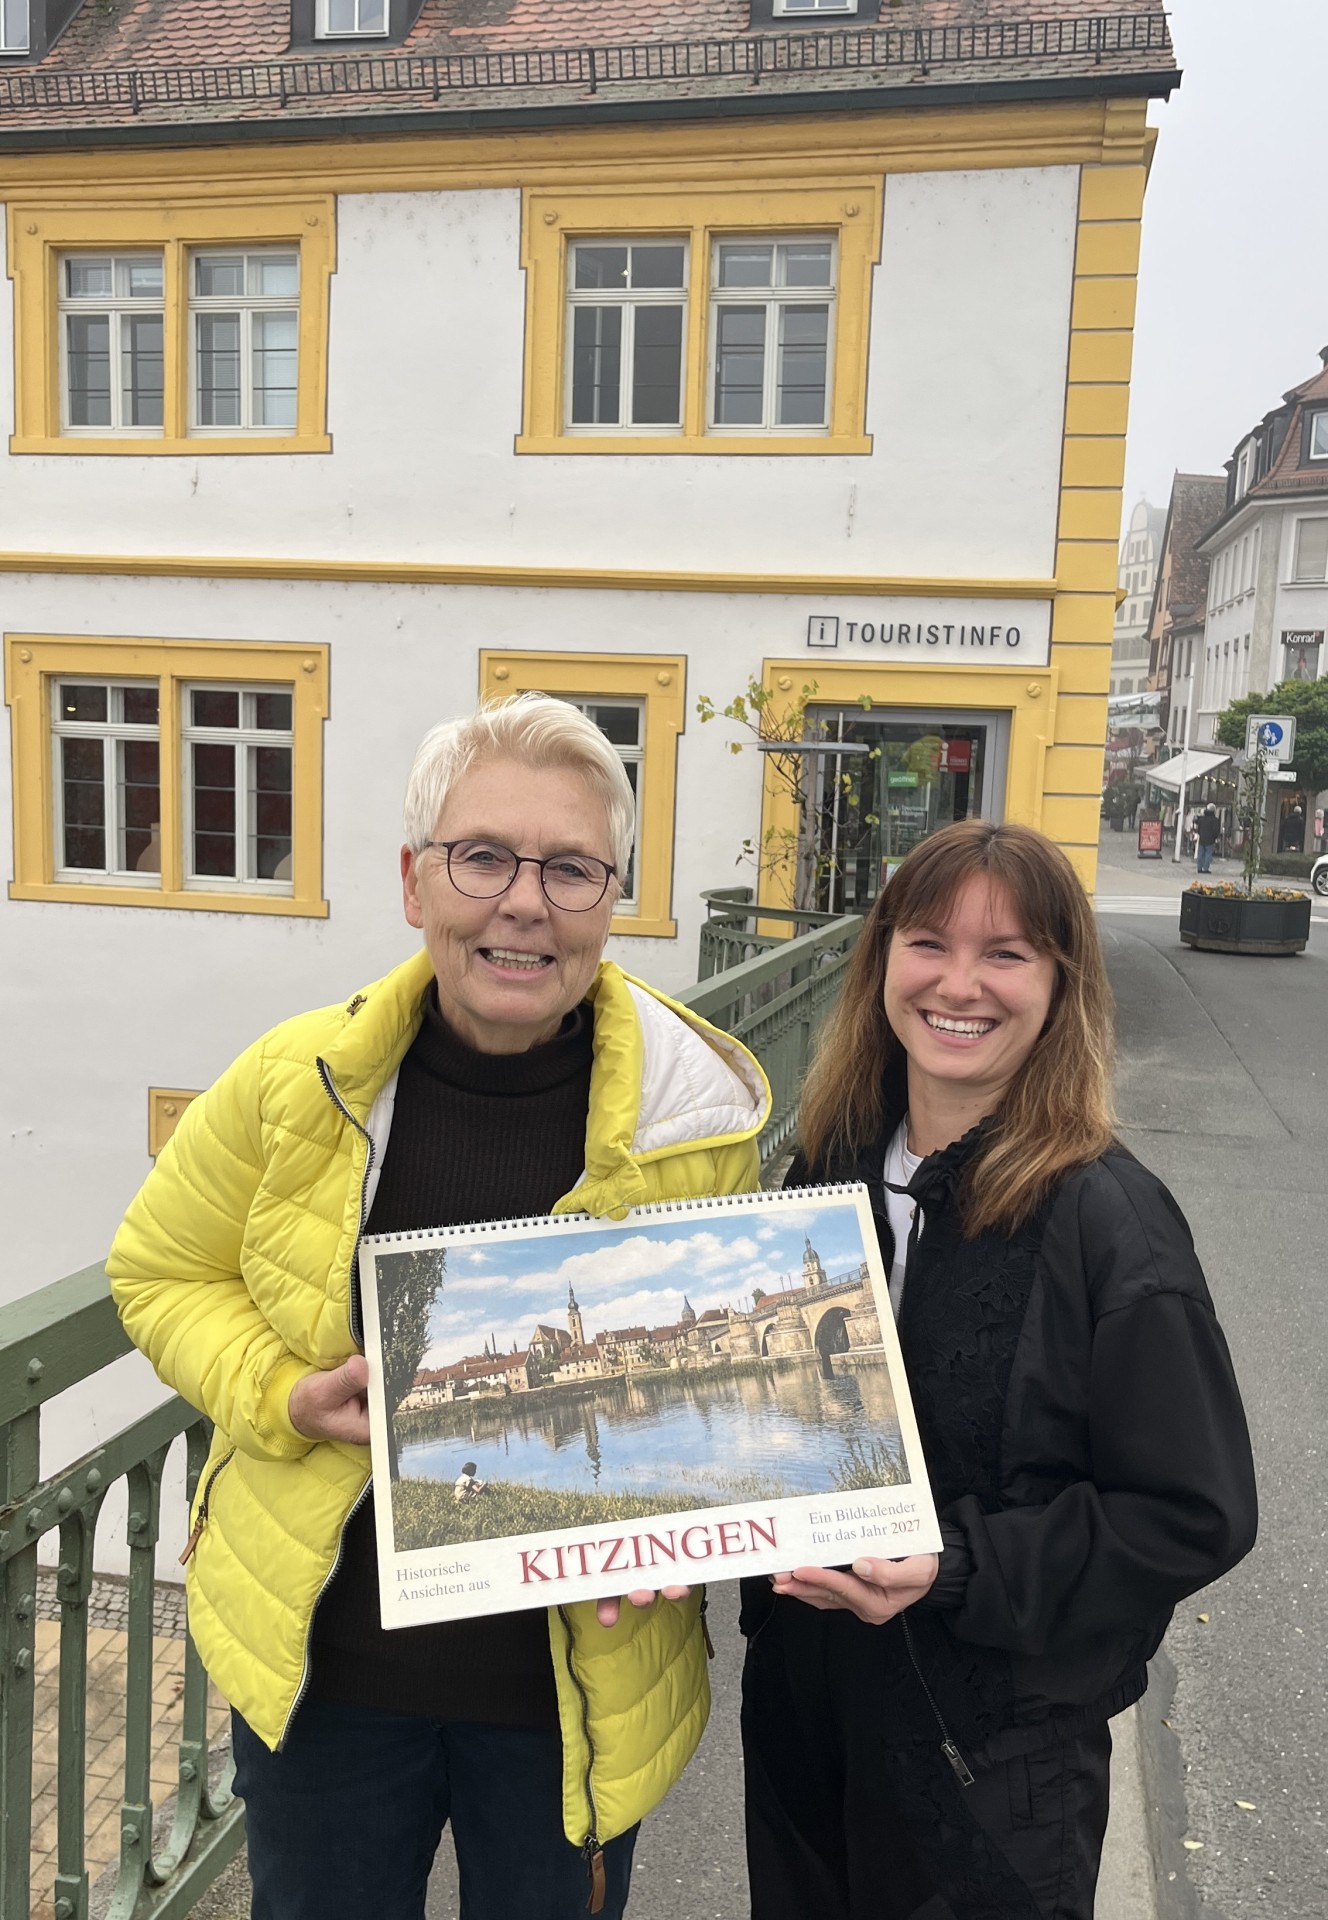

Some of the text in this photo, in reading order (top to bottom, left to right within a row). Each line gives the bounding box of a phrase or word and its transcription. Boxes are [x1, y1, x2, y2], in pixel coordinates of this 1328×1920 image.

[846, 622, 1021, 647] TOURISTINFO
[1286, 631, 1316, 643] Konrad
[808, 1502, 916, 1525] Ein Bildkalender
[811, 1519, 921, 1543] für das Jahr 2027
[517, 1516, 778, 1584] KITZINGEN
[396, 1561, 471, 1582] Historische
[397, 1579, 491, 1601] Ansichten aus
